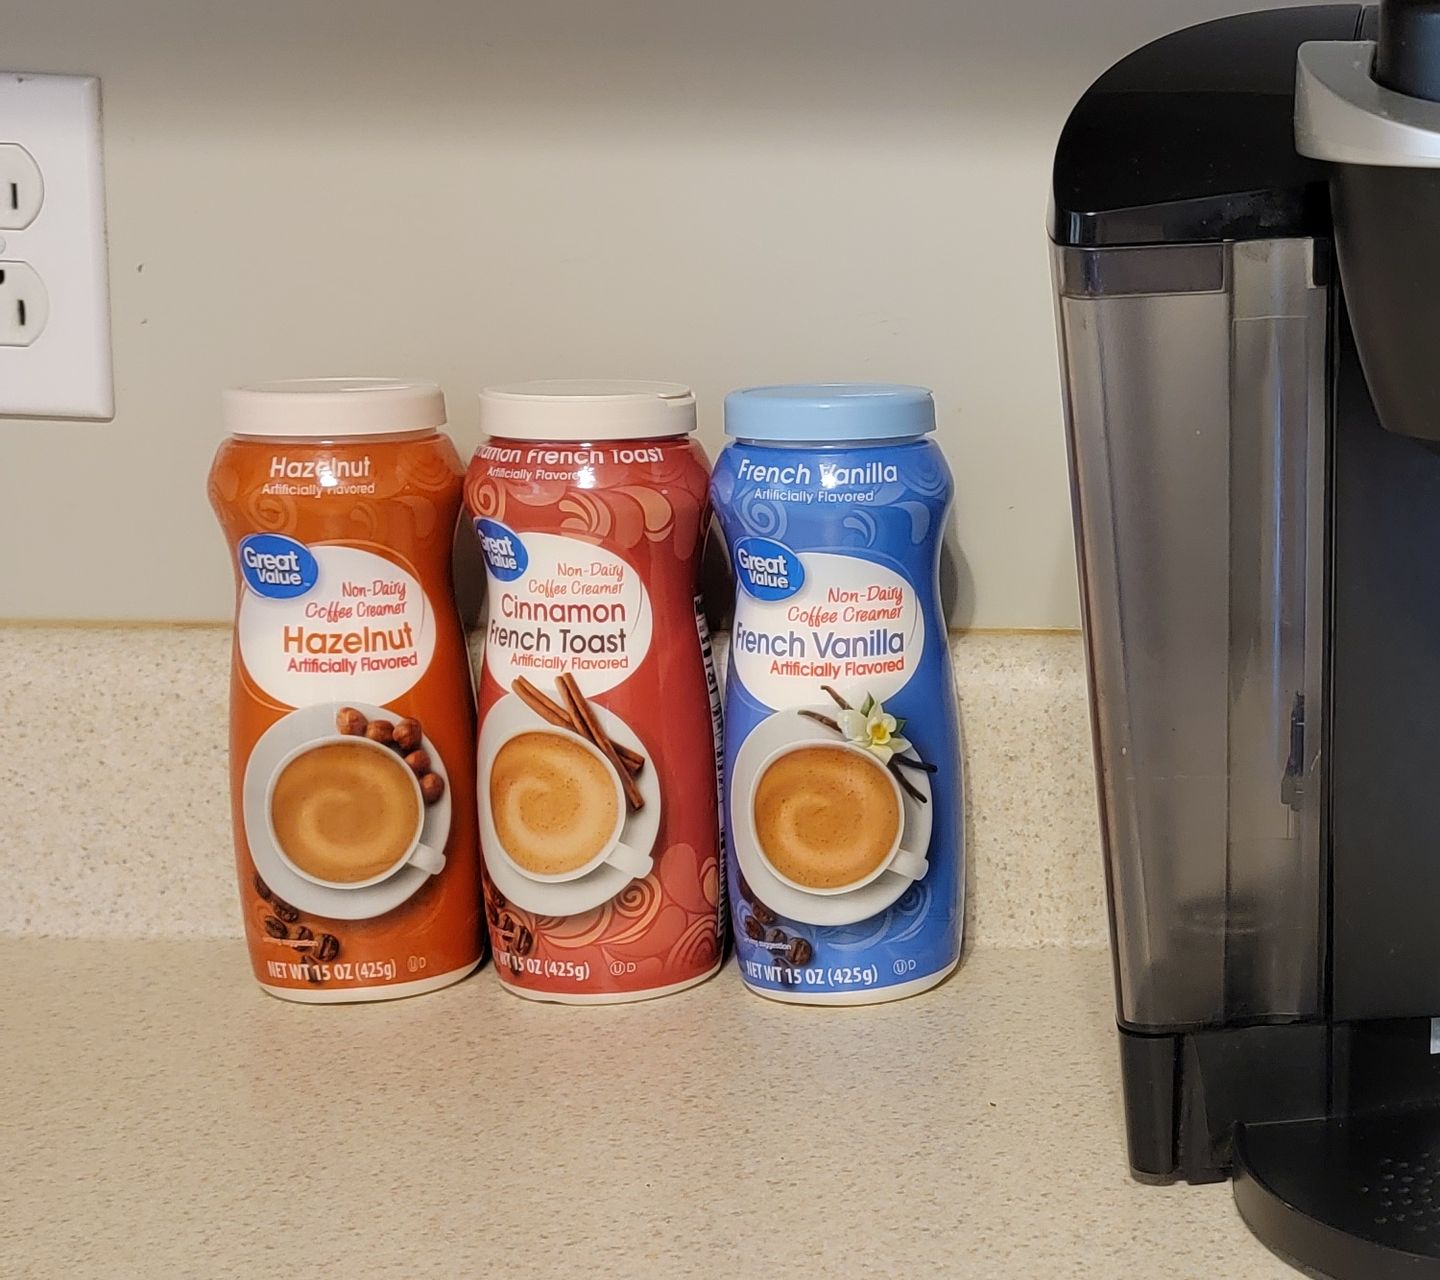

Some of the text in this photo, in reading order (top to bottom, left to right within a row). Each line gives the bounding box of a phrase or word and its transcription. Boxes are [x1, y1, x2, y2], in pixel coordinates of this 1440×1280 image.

[527, 449, 604, 465] French
[613, 447, 664, 464] Toast
[270, 457, 370, 478] Hazelnut
[487, 467, 533, 480] Artificially
[737, 459, 898, 485] French Vanilla
[262, 484, 322, 498] Artificially
[755, 488, 873, 504] Artificially Flavored
[477, 530, 514, 556] Great
[243, 547, 299, 571] Great
[488, 553, 516, 570] Value
[738, 548, 787, 575] Great
[257, 569, 301, 585] Value
[558, 562, 624, 581] Non-Dairy
[749, 572, 788, 588] Value
[342, 580, 406, 600] Non-Dairy
[529, 580, 624, 598] Coffee Creamer
[828, 586, 903, 605] Non-Dairy
[305, 601, 406, 622] Coffee Creamer
[501, 594, 626, 623] Cinnamon
[788, 606, 903, 627] Coffee Creamer
[284, 622, 413, 654] Hazelnut
[489, 620, 627, 653] French Toast
[736, 622, 904, 659] French Vanilla
[288, 652, 417, 675] Artificially Flavored
[511, 653, 629, 671] Artificially Flavored
[770, 658, 904, 679] Artificially Flavored
[267, 959, 396, 982] NET WT 15 OZ (425g)
[512, 956, 590, 981] 15 OZ (425g)
[746, 960, 878, 987] NET WT 15 OZ (425g)
